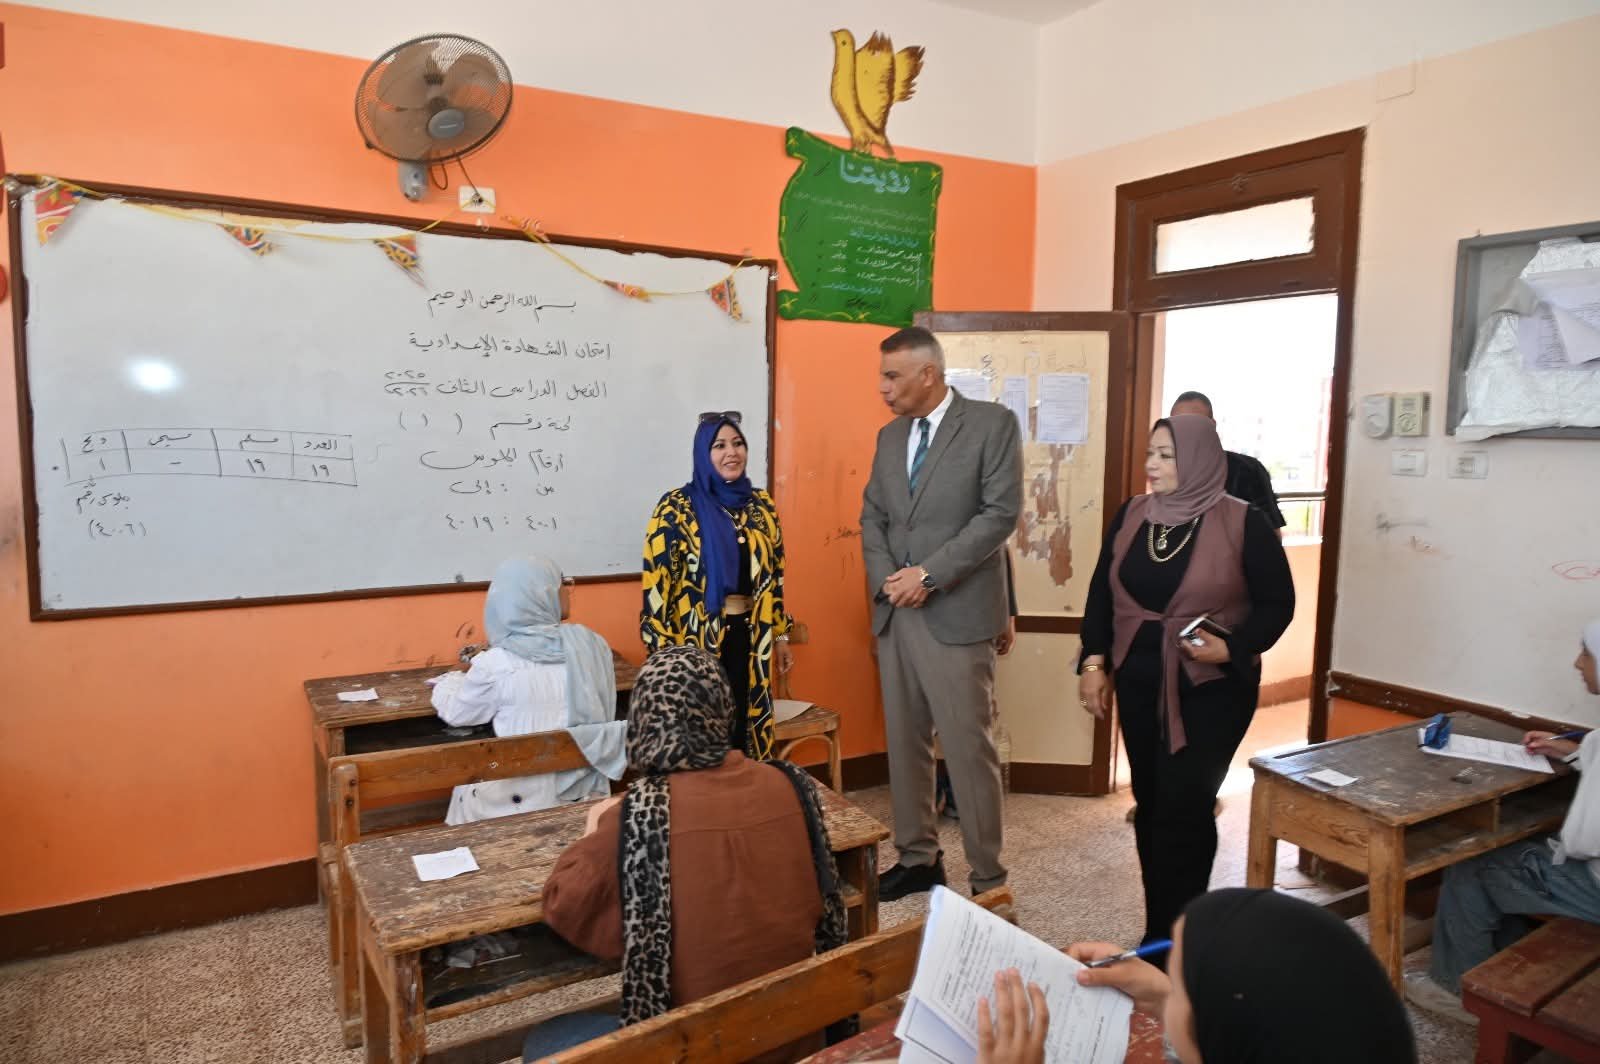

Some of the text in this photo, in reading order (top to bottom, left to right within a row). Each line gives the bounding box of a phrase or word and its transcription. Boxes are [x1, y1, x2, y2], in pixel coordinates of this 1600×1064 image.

[427, 289, 577, 323] بسم الله الرحمن الرحيم
[409, 331, 499, 357] الإعدادية
[503, 336, 568, 357] الشهادة
[566, 379, 608, 401] الفصل
[490, 412, 543, 441] رقم
[303, 439, 338, 451] العدد
[419, 447, 518, 470] الجلوس
